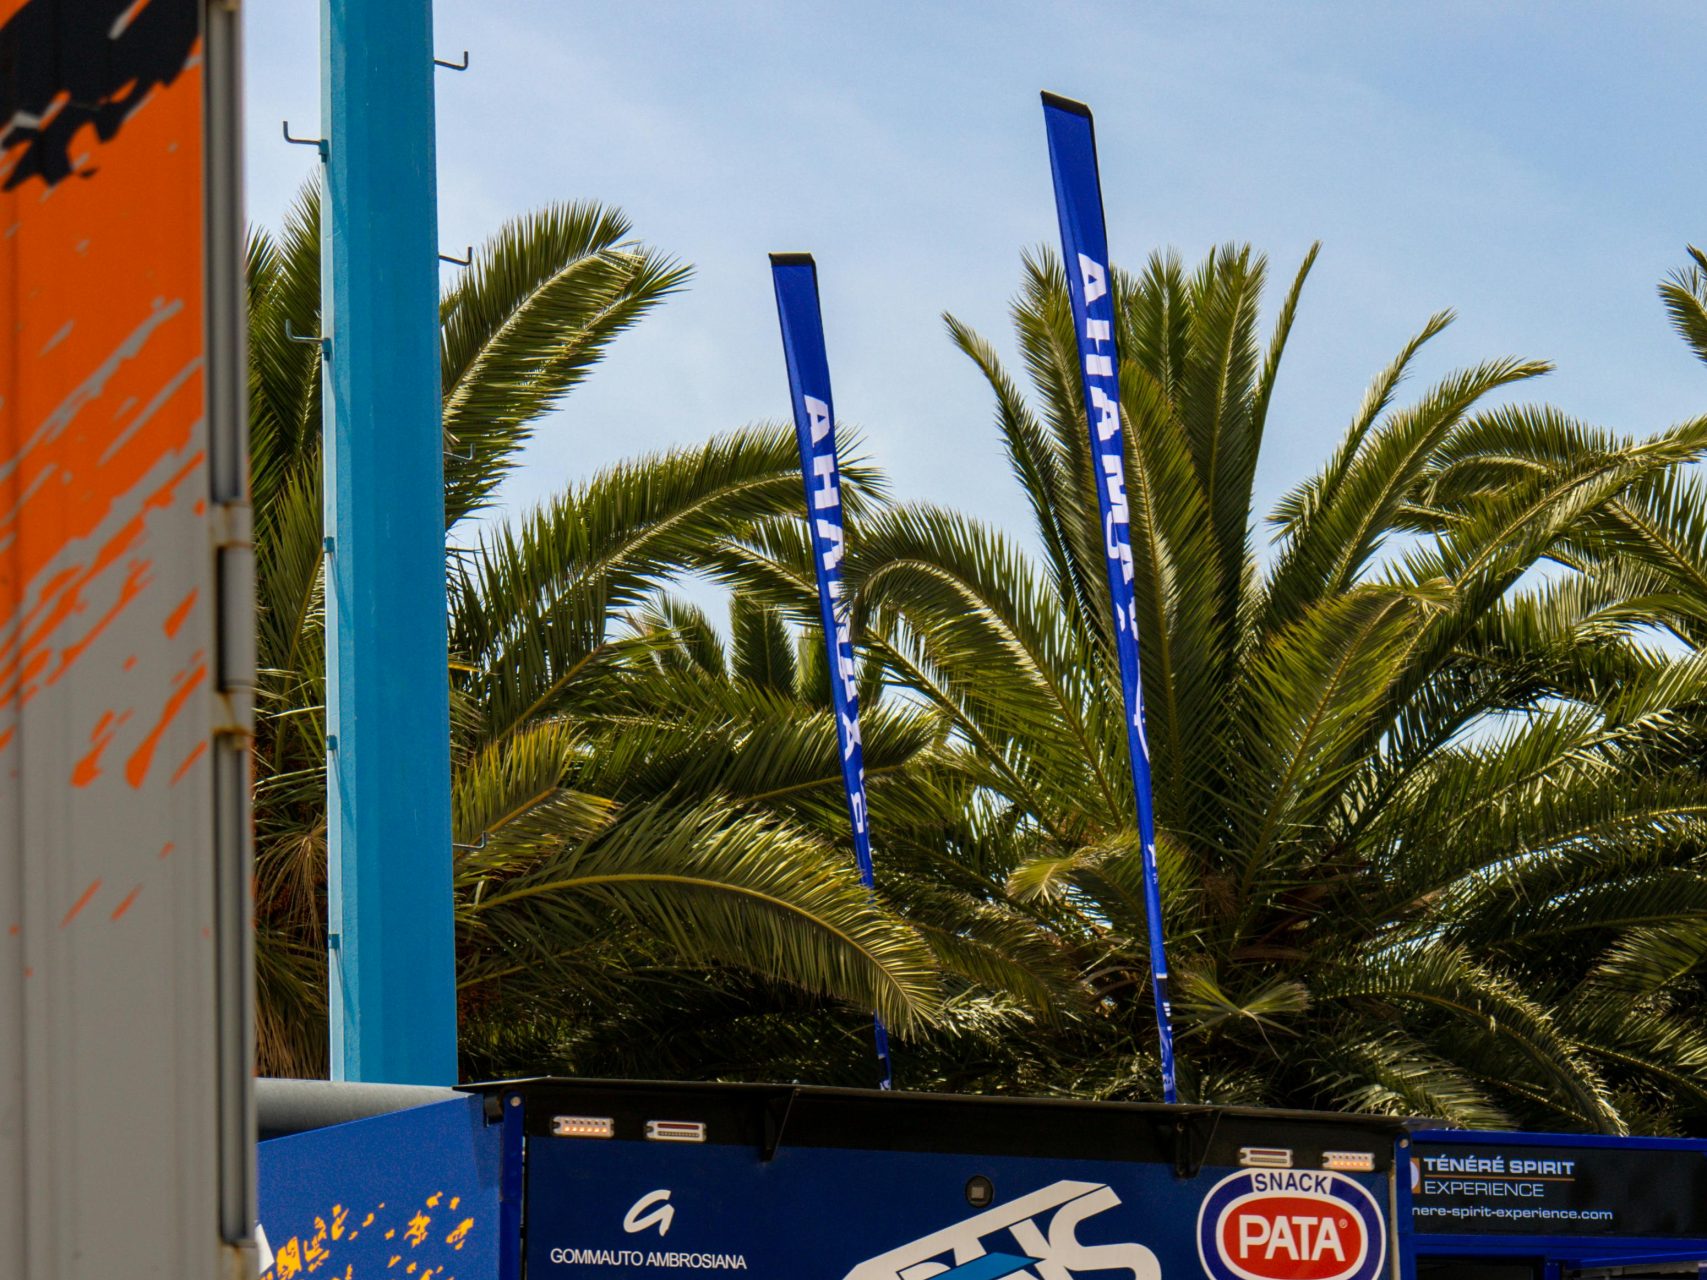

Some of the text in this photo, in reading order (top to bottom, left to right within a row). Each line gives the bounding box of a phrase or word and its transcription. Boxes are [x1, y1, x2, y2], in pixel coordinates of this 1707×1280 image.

[1424, 1154, 1575, 1175] TÉNÉRÉ SPIRIT
[1254, 1172, 1328, 1195] SNACK
[1424, 1181, 1544, 1197] EXPERIENCE
[1412, 1206, 1613, 1220] nere-spirit-experience.com
[1239, 1214, 1346, 1262] PATA
[550, 1248, 748, 1270] GOMMAUTO AMBROSIANA
